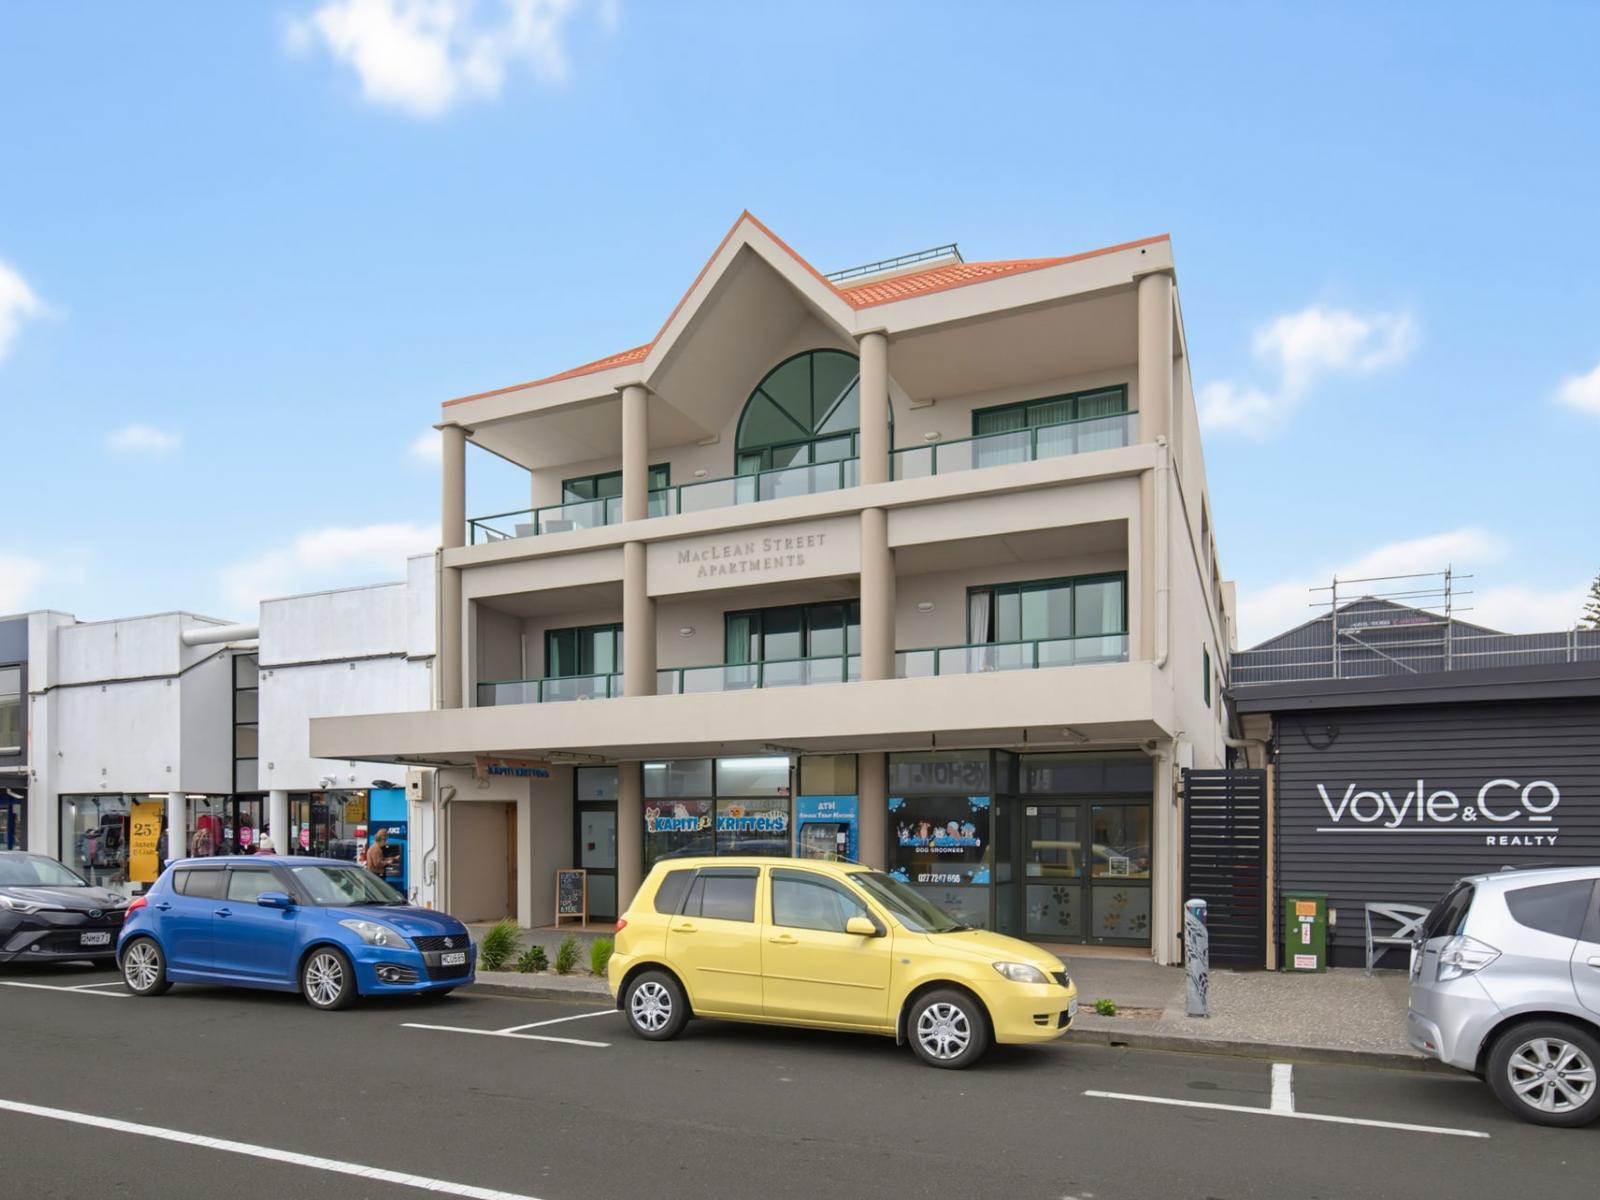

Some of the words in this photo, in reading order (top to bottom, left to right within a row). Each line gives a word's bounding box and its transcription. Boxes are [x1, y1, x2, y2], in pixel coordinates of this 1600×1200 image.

[762, 534, 827, 552] STREET
[697, 554, 805, 578] APARTMENTS
[817, 801, 836, 810] ATM
[655, 815, 699, 832] KAPITI
[1486, 835, 1558, 846] REALTY
